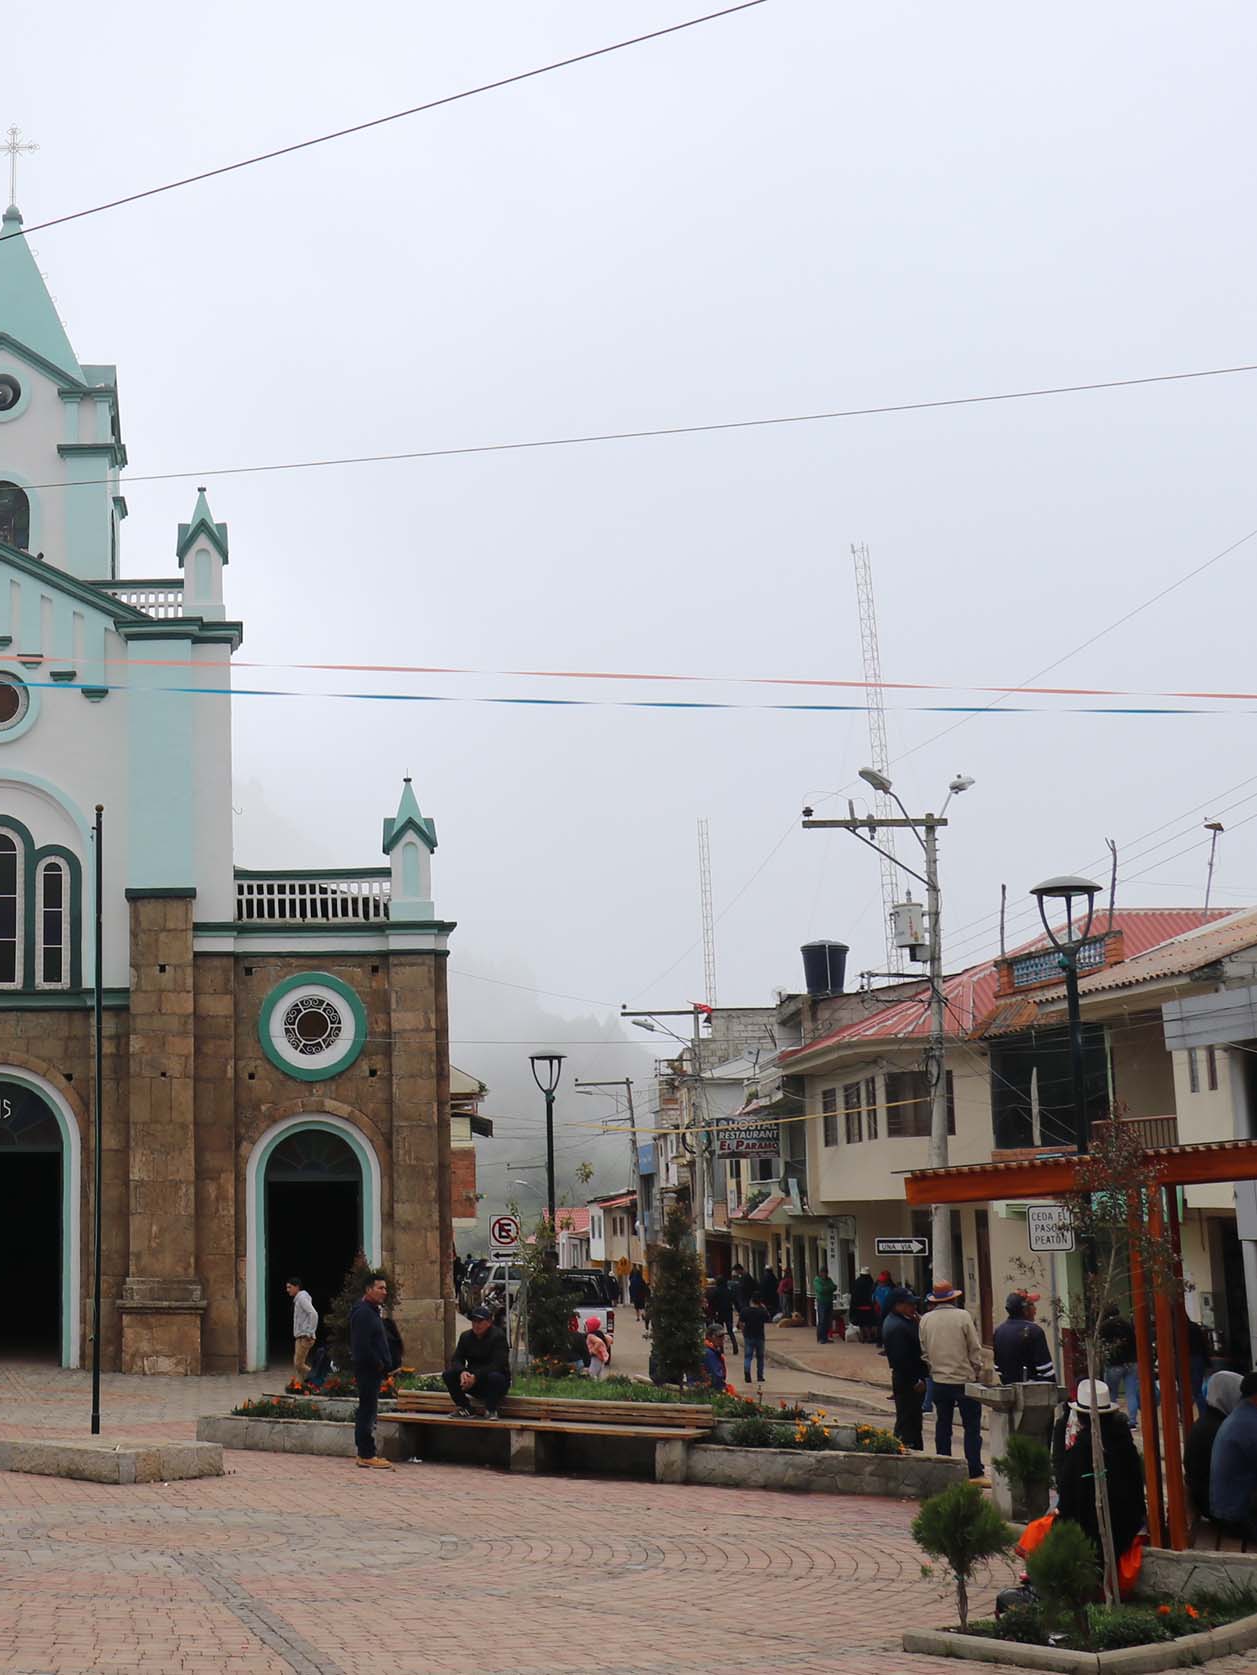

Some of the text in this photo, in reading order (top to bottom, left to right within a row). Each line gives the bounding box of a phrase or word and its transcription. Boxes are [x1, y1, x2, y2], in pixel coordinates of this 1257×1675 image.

[728, 1120, 777, 1131] HOSTAL
[719, 1130, 777, 1139] RESTAURANT
[1031, 1212, 1054, 1222] CEDA
[1034, 1223, 1057, 1232] PASO
